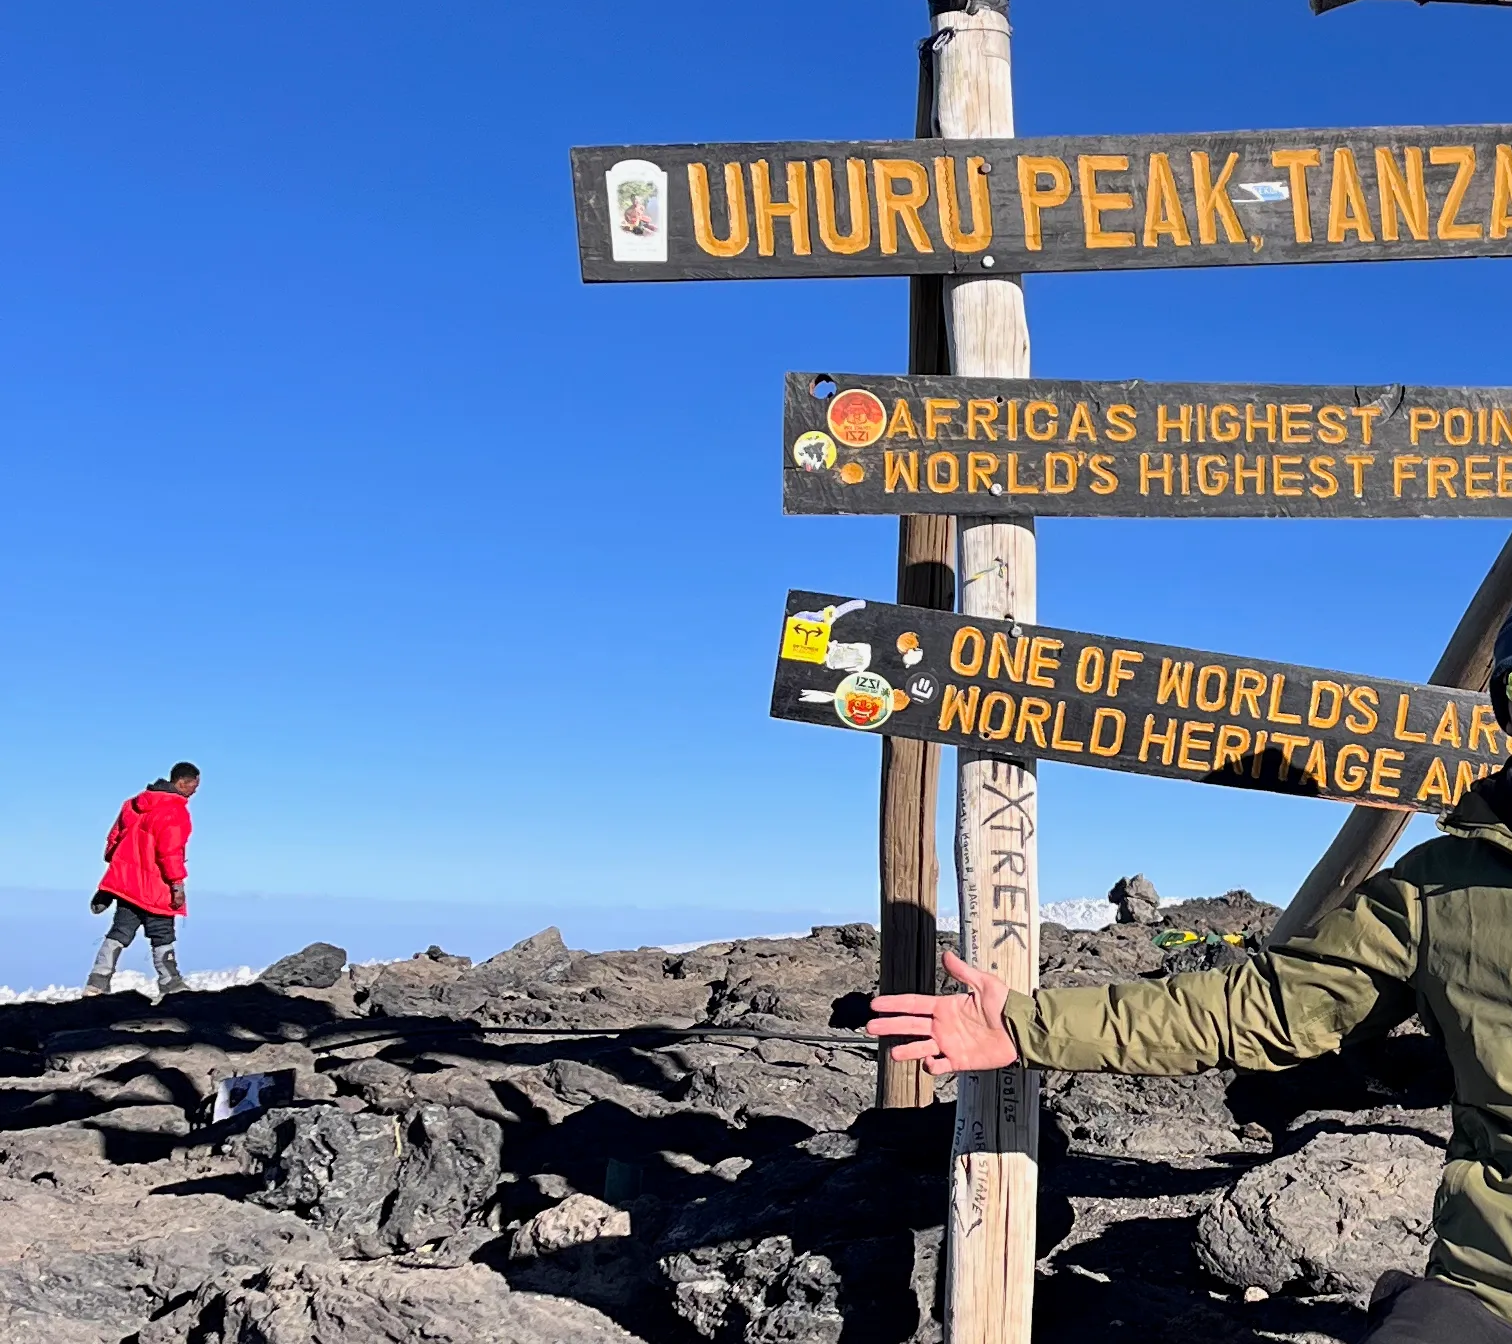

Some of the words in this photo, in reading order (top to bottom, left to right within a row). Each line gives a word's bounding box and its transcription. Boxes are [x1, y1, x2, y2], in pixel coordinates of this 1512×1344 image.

[689, 156, 994, 258] UHURU
[1018, 151, 1262, 253] PEAK,
[884, 451, 1119, 495] WORLD'S
[1139, 453, 1374, 498] HIGHEST
[1157, 403, 1382, 445] HIGHEST
[951, 626, 1064, 690] ONE
[1076, 647, 1143, 697] OF
[1157, 658, 1379, 736] WORLD'S
[939, 685, 1127, 758] WORLD
[1139, 715, 1406, 799] HERITAGE
